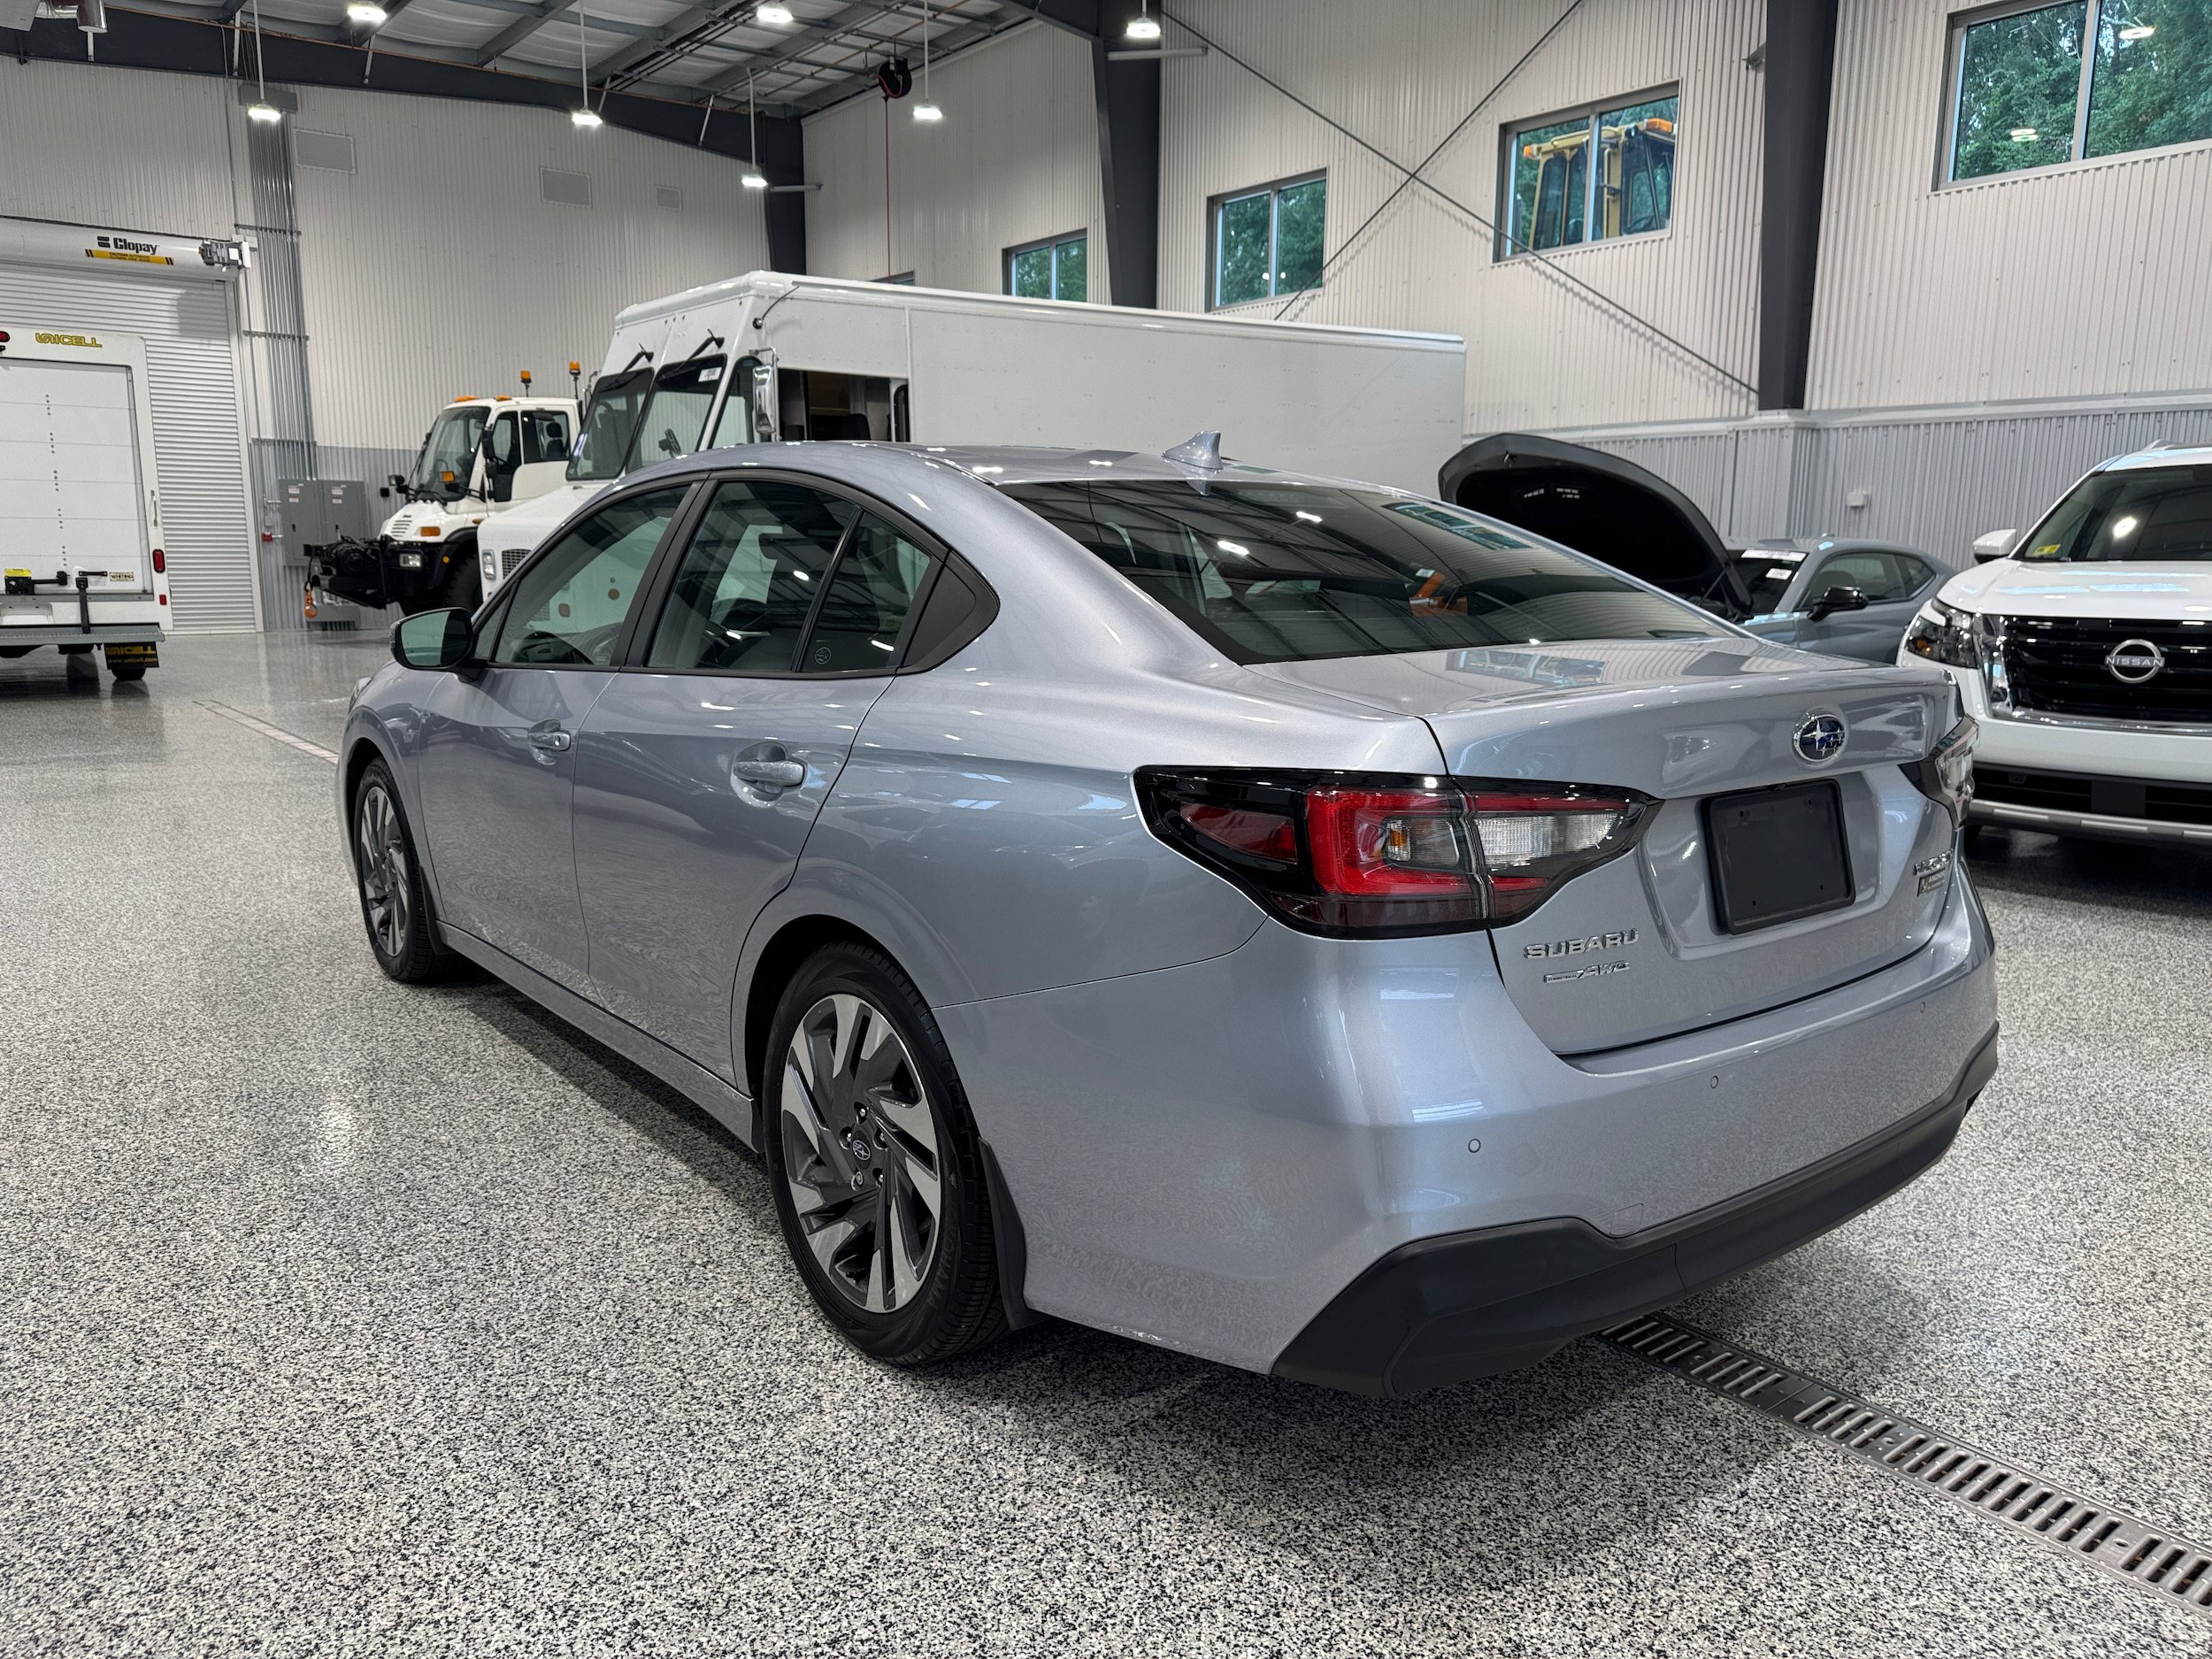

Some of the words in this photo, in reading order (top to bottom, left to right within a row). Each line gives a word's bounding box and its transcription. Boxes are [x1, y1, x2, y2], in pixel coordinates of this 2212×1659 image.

[113, 237, 157, 256] Clopay
[35, 333, 103, 348] UNICELL
[2106, 657, 2163, 667] NISSAN
[1524, 927, 1640, 960] SUBARU
[1578, 960, 1631, 979] AWD
